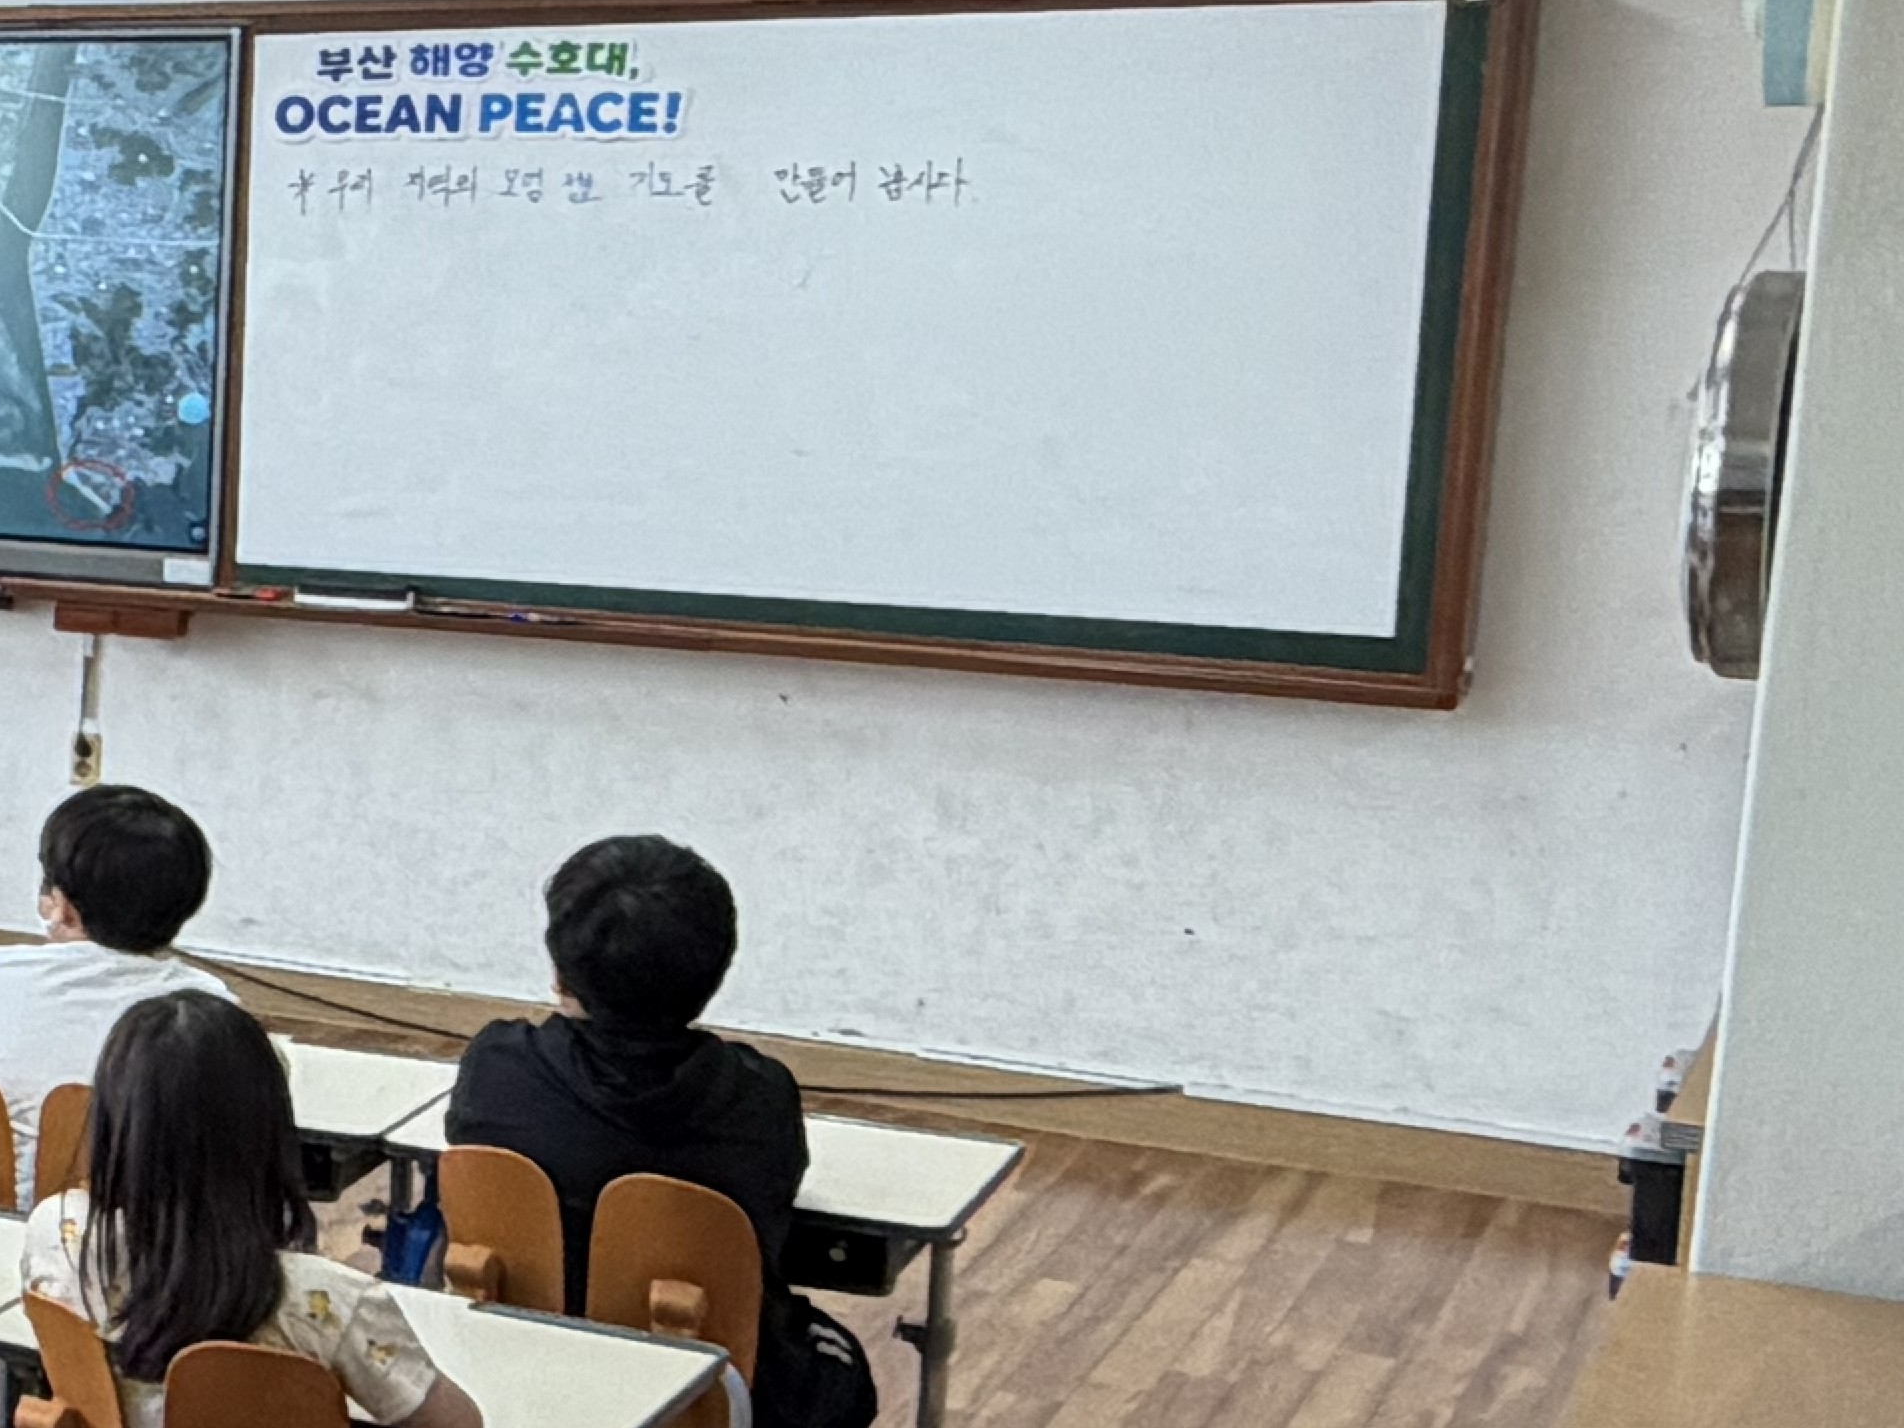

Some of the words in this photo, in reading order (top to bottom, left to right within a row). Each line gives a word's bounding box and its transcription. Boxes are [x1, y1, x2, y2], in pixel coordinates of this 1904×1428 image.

[317, 44, 397, 82] 부산
[409, 42, 492, 78] 해양
[505, 40, 640, 80] 수호대,
[275, 93, 463, 135] OCEAN
[479, 91, 683, 135] PEACE!
[327, 167, 373, 213] 우리
[404, 163, 479, 209] 지역의
[628, 159, 716, 206] 지도를
[772, 160, 856, 204] 만들어
